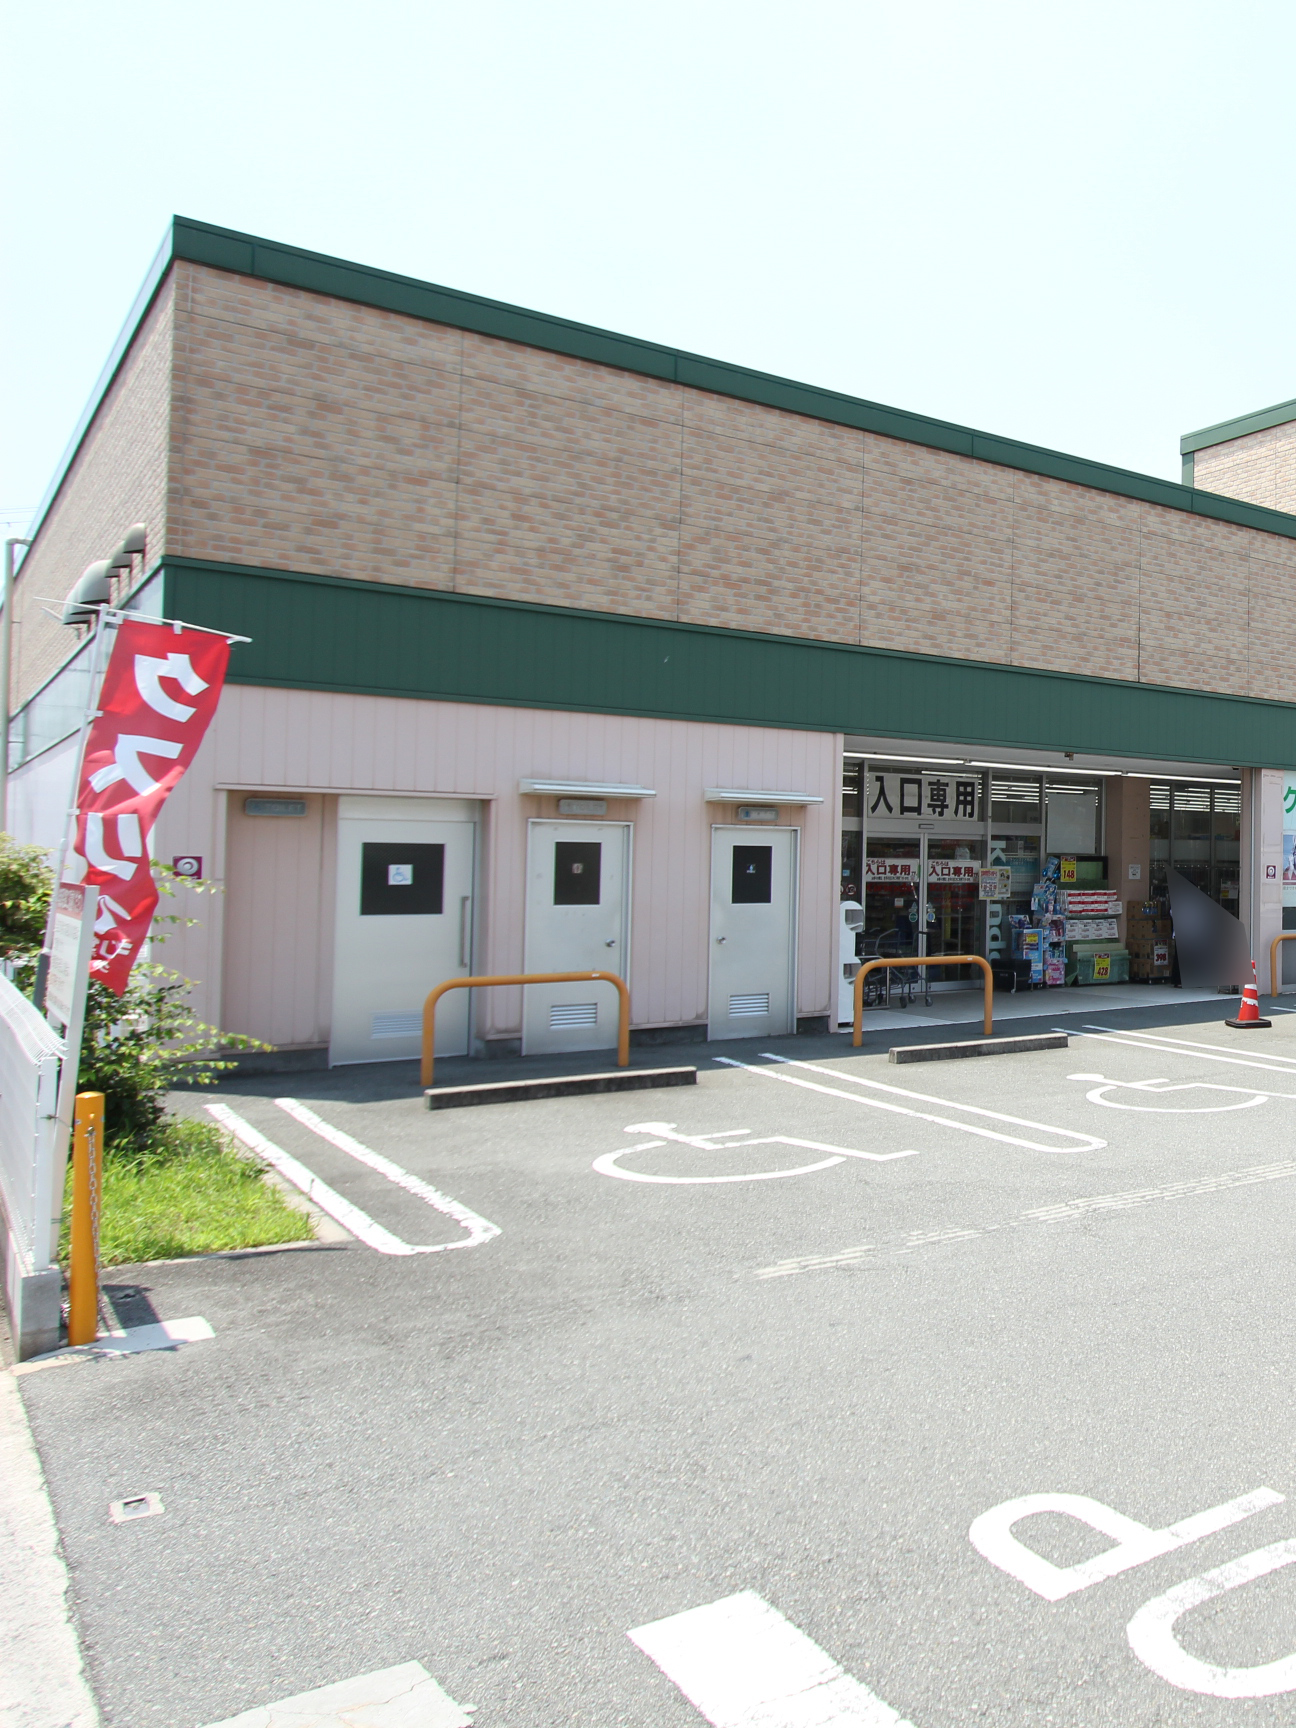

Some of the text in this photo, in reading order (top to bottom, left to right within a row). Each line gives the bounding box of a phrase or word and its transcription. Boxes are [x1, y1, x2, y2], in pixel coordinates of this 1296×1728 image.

[870, 775, 977, 819] 入口専用
[1063, 869, 1075, 879] 148
